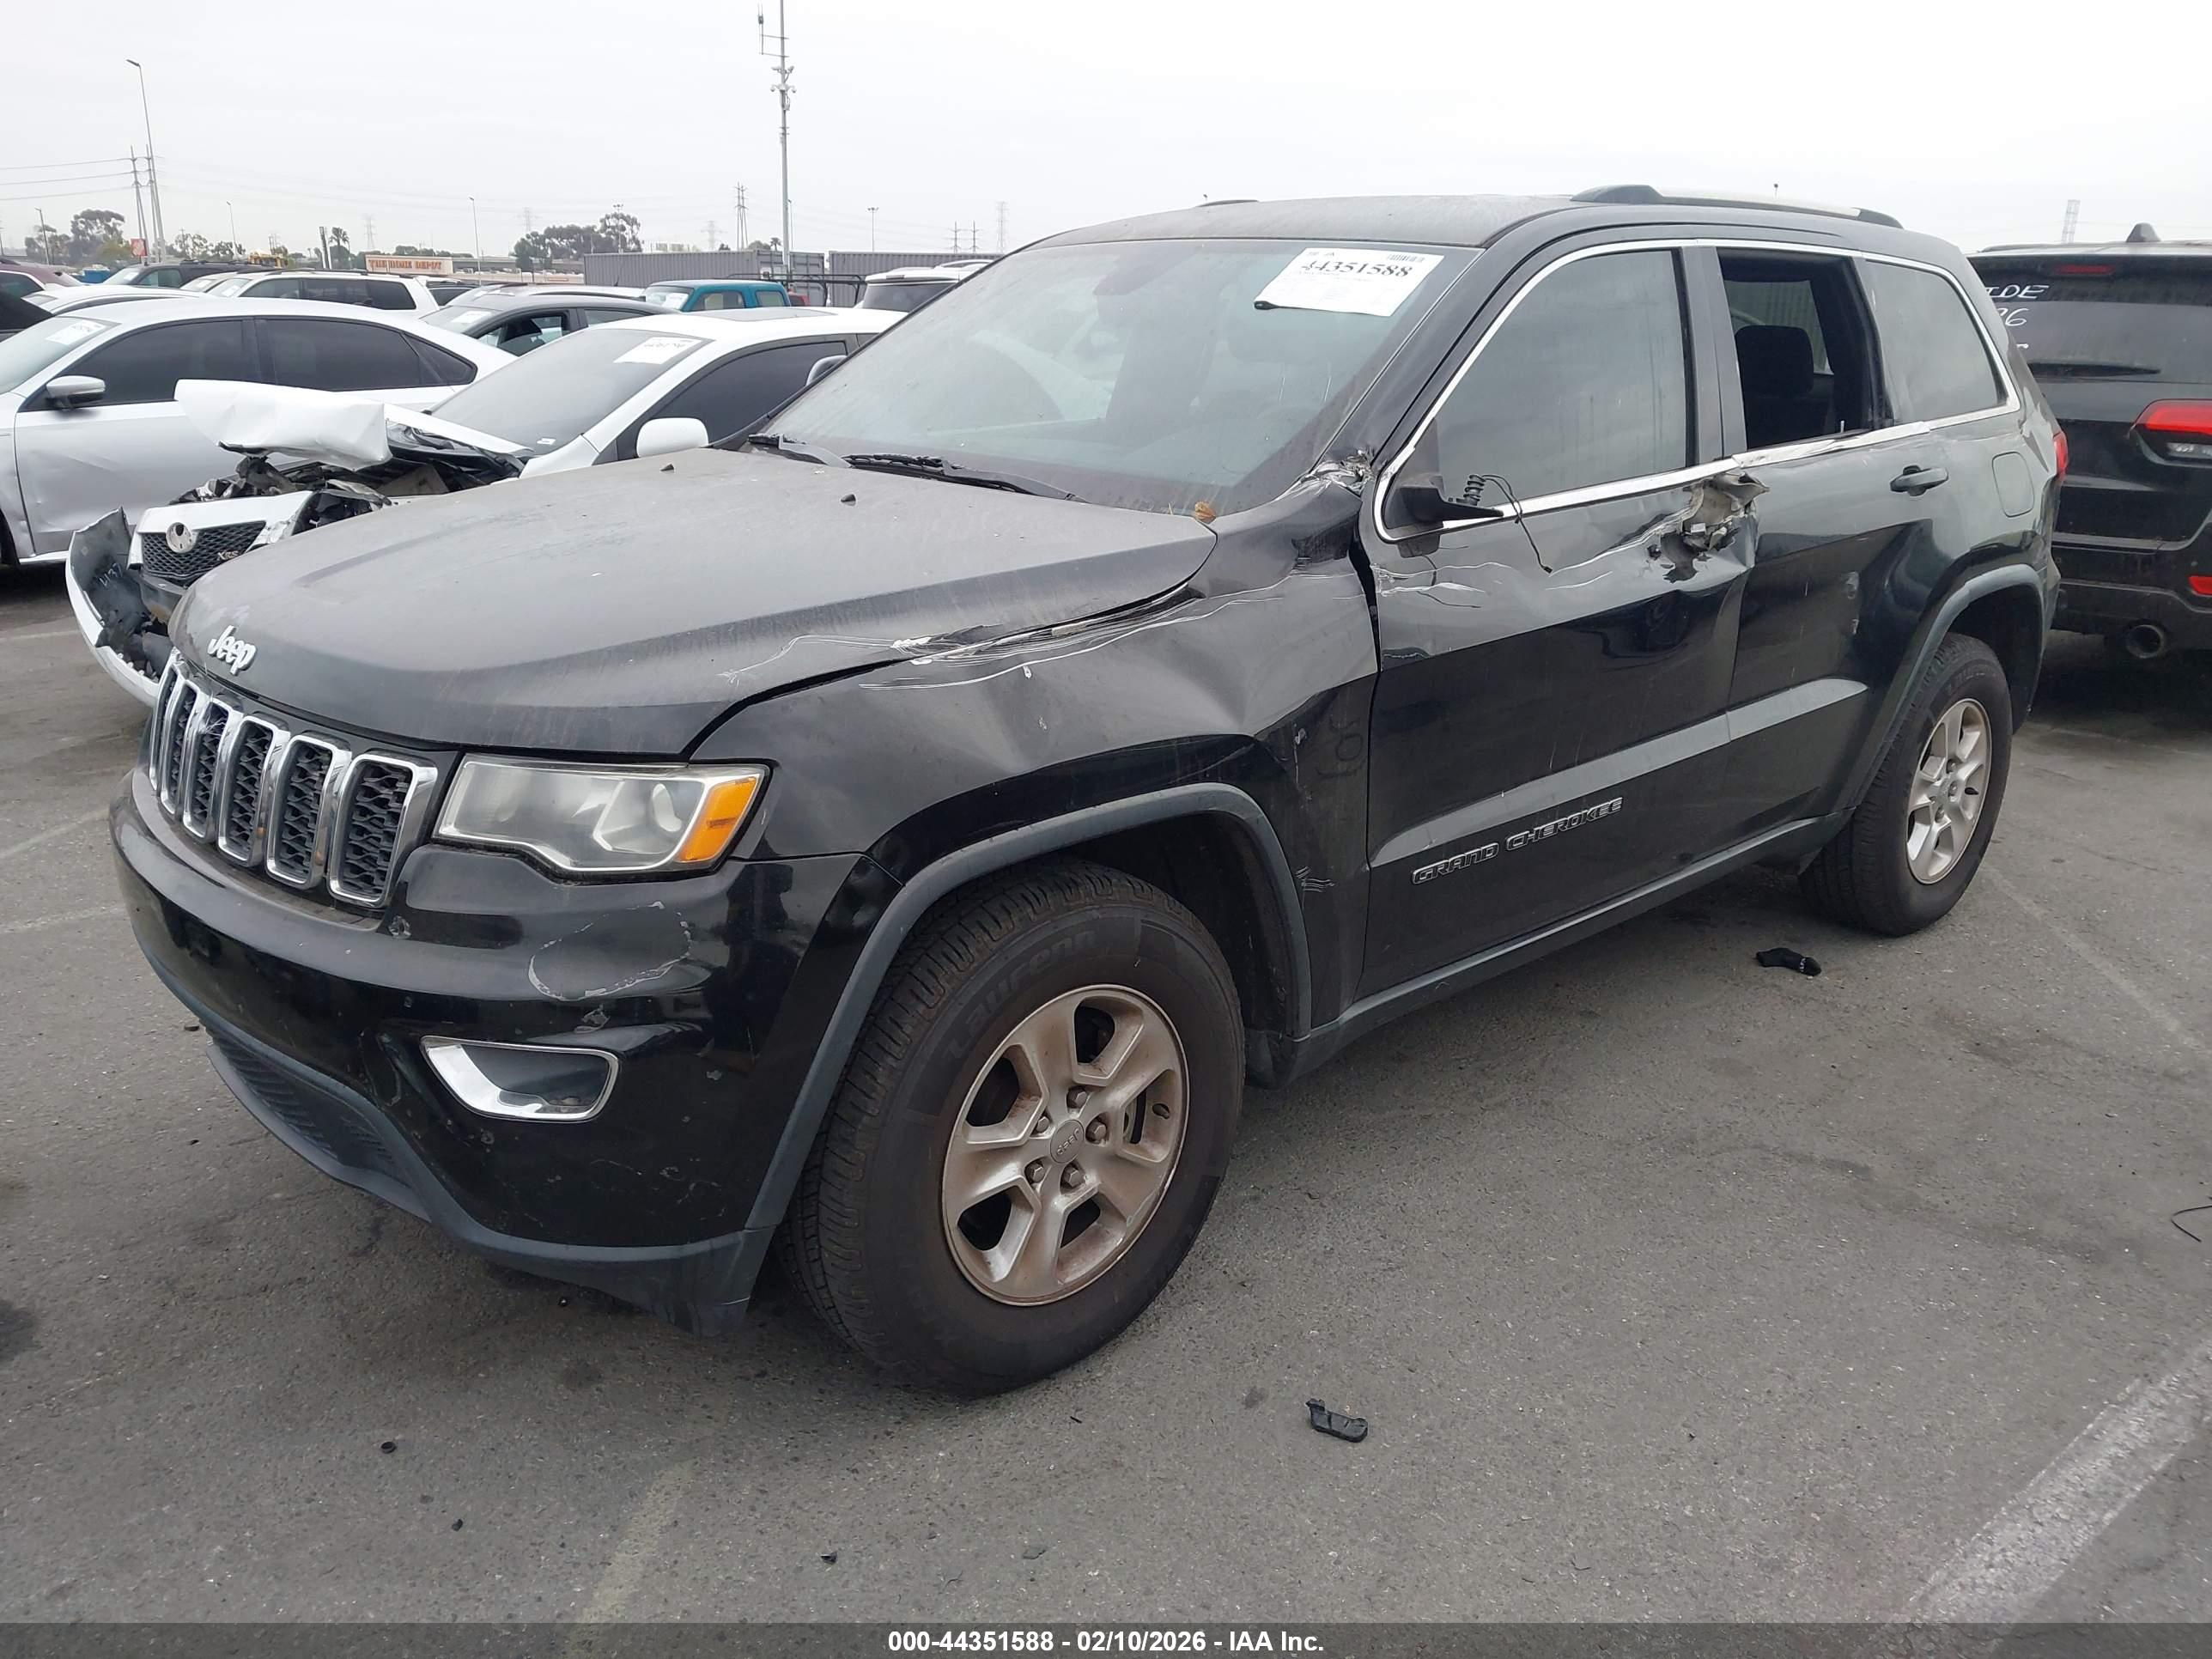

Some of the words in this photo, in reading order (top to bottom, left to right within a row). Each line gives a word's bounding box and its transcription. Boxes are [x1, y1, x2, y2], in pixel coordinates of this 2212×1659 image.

[1301, 259, 1413, 277] 44351588
[207, 625, 257, 675] Jeep
[1411, 842, 1499, 884] GRAND
[1505, 797, 1624, 851] CHEROKEE
